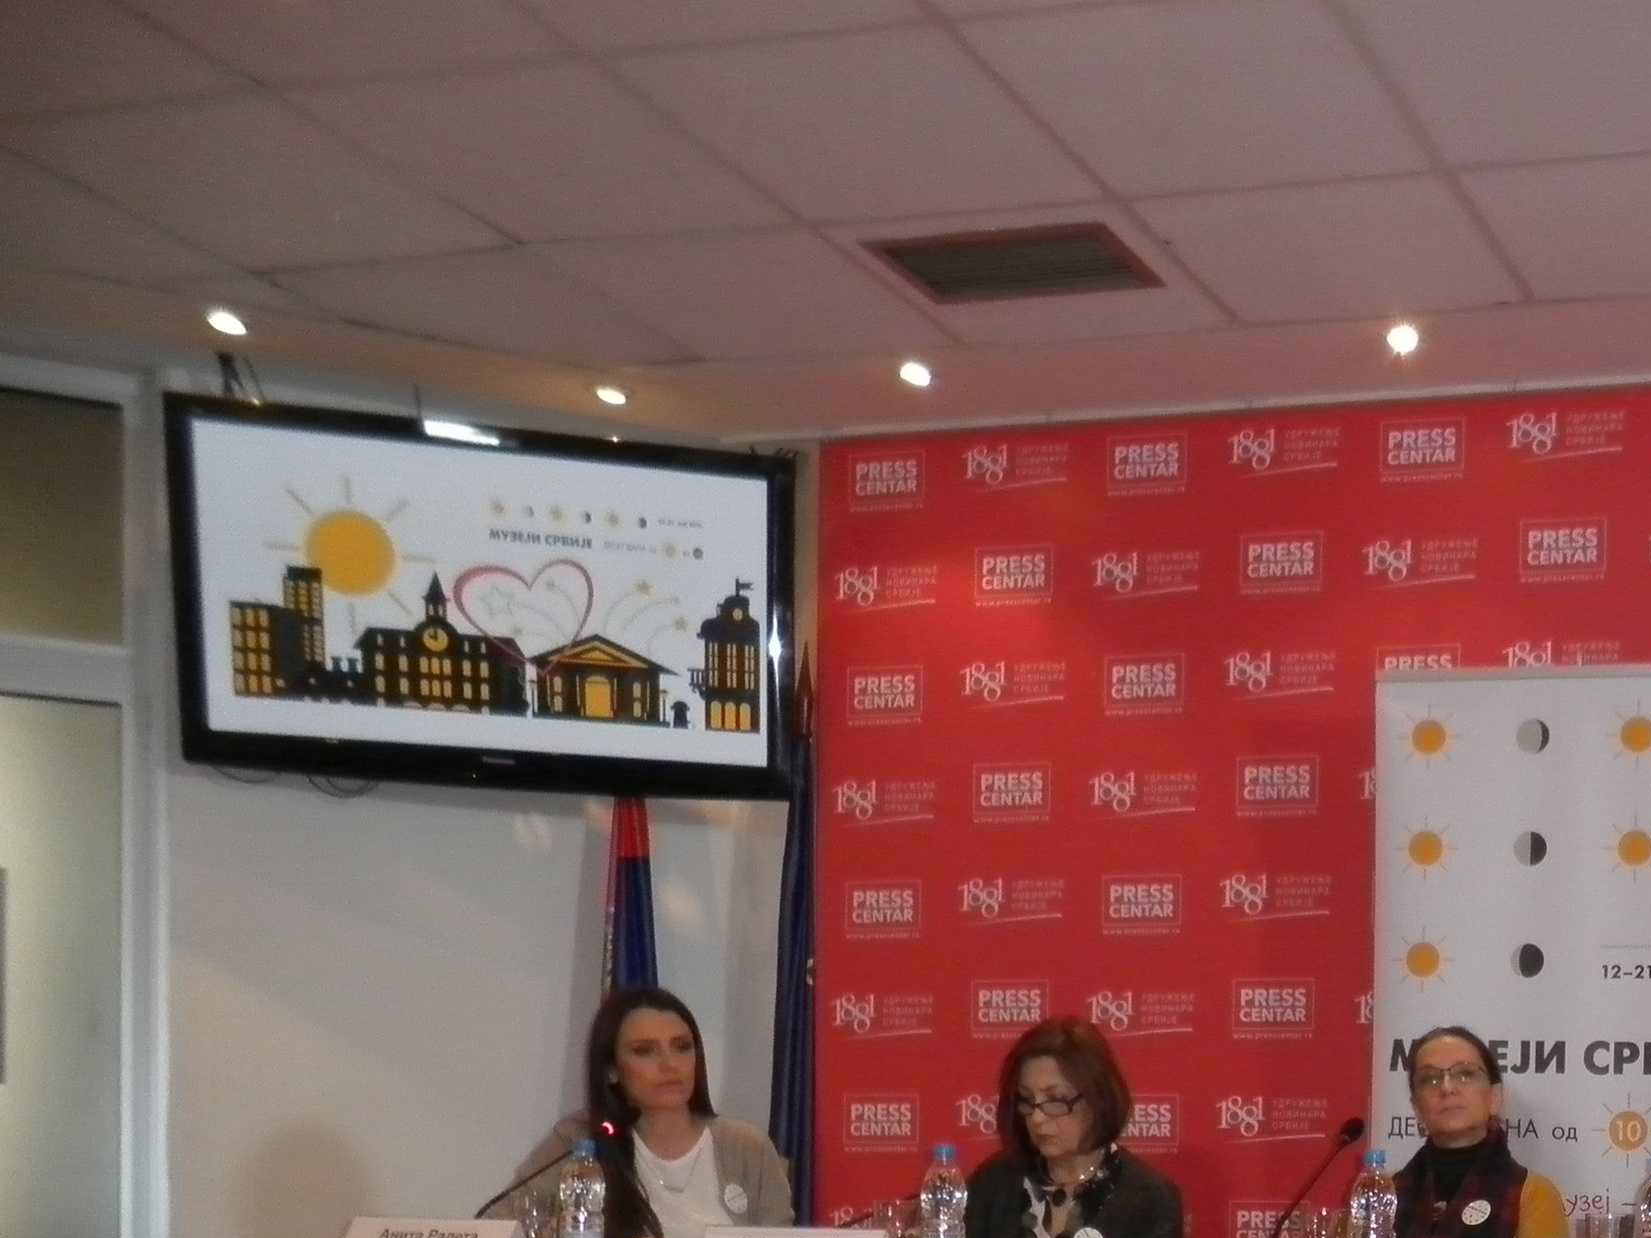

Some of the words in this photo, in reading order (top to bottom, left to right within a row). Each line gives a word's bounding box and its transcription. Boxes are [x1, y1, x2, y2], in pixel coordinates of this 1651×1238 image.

[1389, 428, 1456, 448] PRESS
[1115, 443, 1178, 464] PRESS
[1388, 446, 1455, 464] CENTAR
[1114, 462, 1178, 479] CENTAR
[1528, 528, 1597, 548] PRESS
[1249, 542, 1314, 562] PRESS
[1528, 546, 1597, 565] CENTAR
[983, 555, 1045, 574] PRESS
[1248, 560, 1313, 577] CENTAR
[982, 572, 1044, 590] CENTAR
[1112, 664, 1176, 683] PRESS
[855, 675, 915, 694] PRESS
[1112, 681, 1175, 699] CENTAR
[854, 692, 914, 708] CENTAR
[981, 772, 1042, 792] PRESS
[1245, 766, 1310, 786] PRESS
[981, 790, 1042, 806] CENTAR
[1244, 782, 1309, 800] CENTAR
[853, 890, 913, 909] PRESS
[1110, 885, 1173, 904] PRESS
[853, 906, 913, 923] CENTAR
[1109, 901, 1173, 918] CENTAR
[979, 990, 1041, 1008] PRESS
[1241, 989, 1306, 1007] PRESS
[978, 1005, 1040, 1022] CENTAR
[1240, 1005, 1305, 1022] CENTAR
[851, 1104, 911, 1122] PRESS
[851, 1119, 911, 1135] CENTAR
[1552, 1128, 1578, 1142] од
[1614, 1120, 1641, 1141] 10
